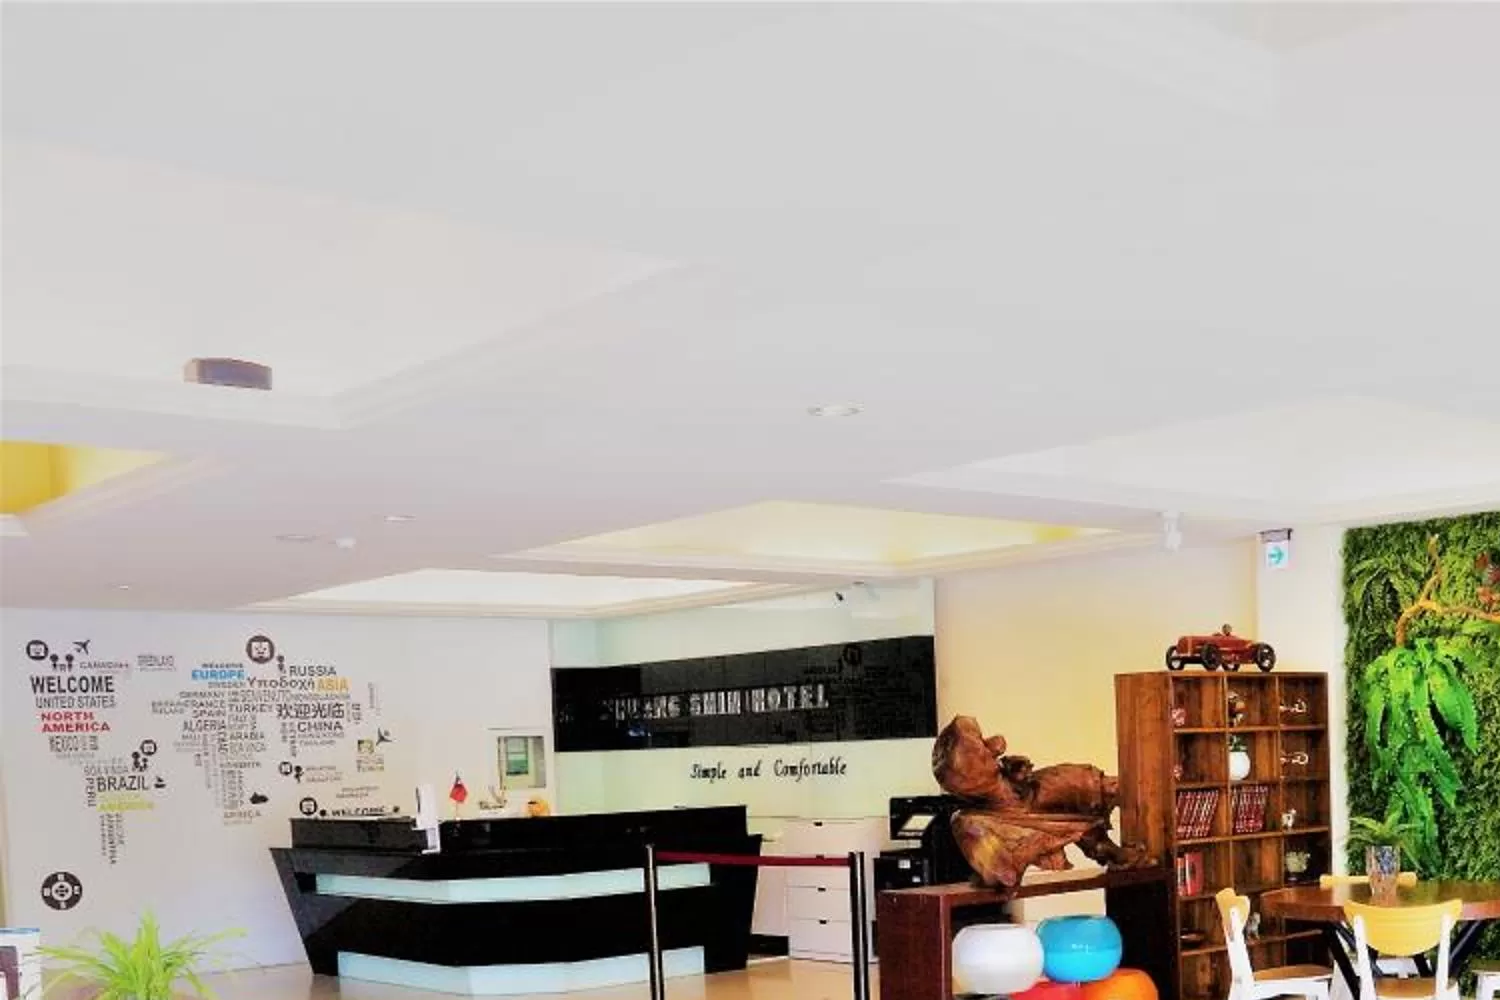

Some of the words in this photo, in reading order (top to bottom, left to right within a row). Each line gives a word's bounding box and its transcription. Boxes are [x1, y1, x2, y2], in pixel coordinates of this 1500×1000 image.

[191, 669, 245, 680] EUROPE
[289, 666, 336, 676] RUSSIA
[31, 675, 115, 693] WELCOME
[317, 678, 348, 690] ASIA
[35, 696, 75, 708] UNITED
[77, 695, 116, 708] STATES
[750, 684, 829, 712] HOTEL
[228, 704, 272, 713] TURKEY
[276, 703, 345, 719] 欢迎光临
[41, 711, 94, 720] NORTH
[41, 722, 111, 732] AMERICA
[183, 719, 226, 732] ALGERIA
[298, 721, 343, 732] CHINA
[690, 762, 726, 783] Simple
[738, 761, 760, 779] and
[774, 756, 847, 783] Comfortable
[97, 776, 149, 791] BRAZIL
[86, 778, 96, 807] PERU
